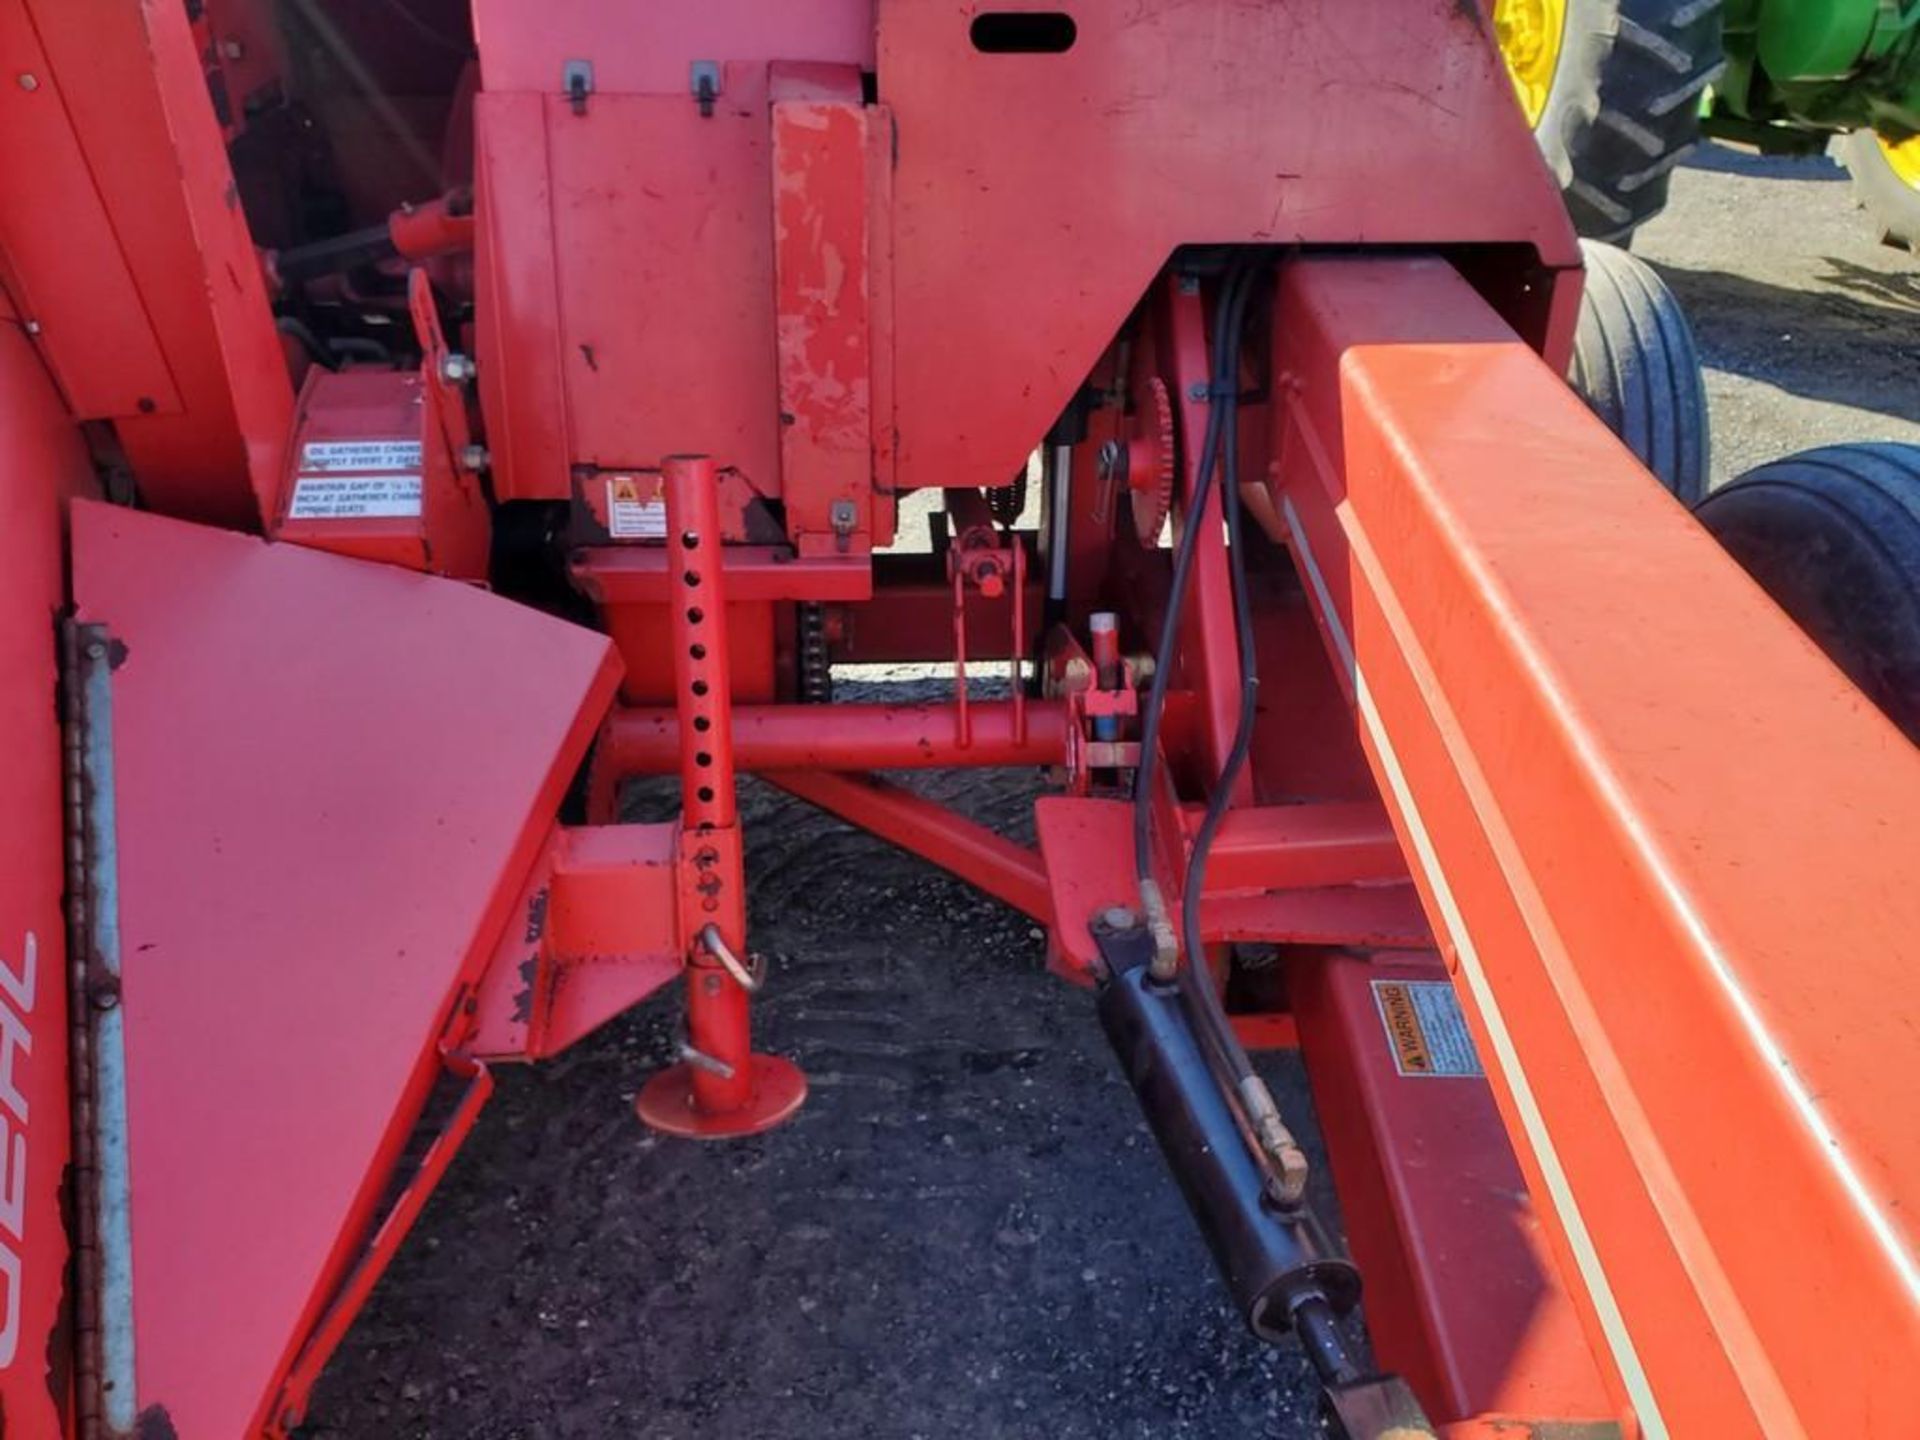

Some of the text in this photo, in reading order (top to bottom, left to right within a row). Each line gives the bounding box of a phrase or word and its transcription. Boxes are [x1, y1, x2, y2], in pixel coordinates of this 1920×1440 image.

[300, 482, 346, 491] MAINTAIN
[350, 481, 370, 491] GAP
[372, 481, 386, 490] OF
[323, 493, 335, 502] AT
[1384, 986, 1419, 1052] WARNING
